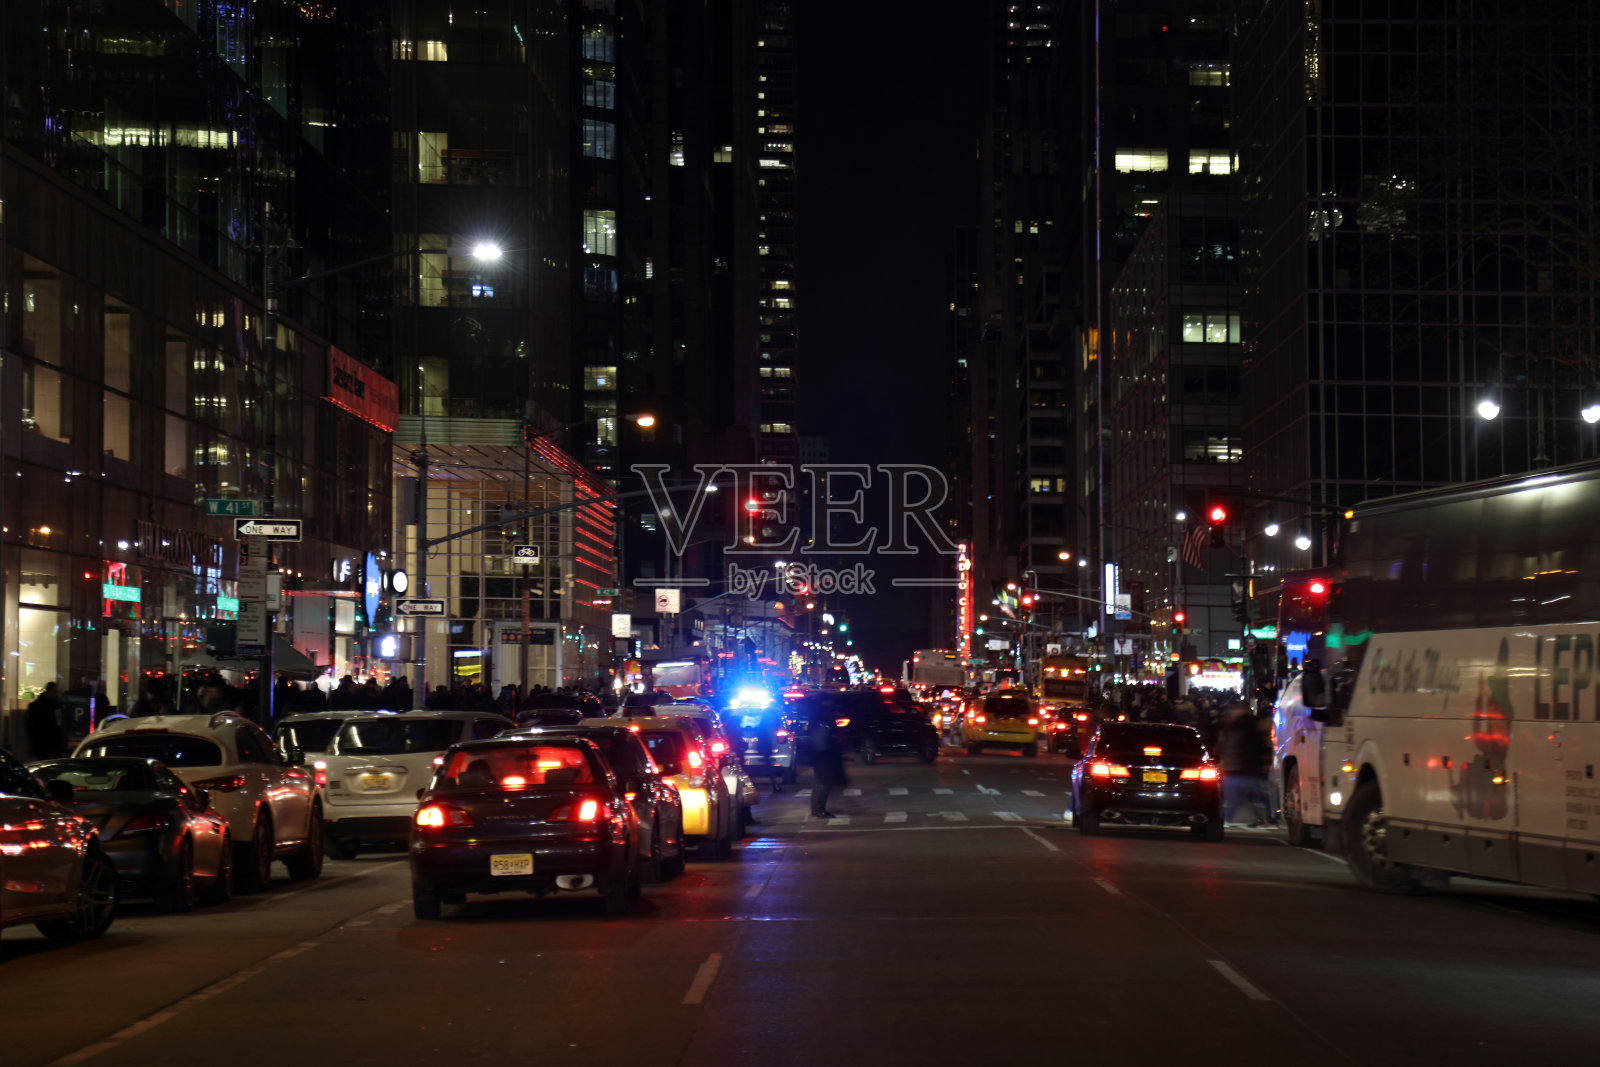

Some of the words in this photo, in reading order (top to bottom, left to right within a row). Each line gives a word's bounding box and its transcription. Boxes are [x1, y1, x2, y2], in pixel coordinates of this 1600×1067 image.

[208, 501, 219, 513] W
[225, 502, 239, 514] 41
[245, 526, 263, 534] ONE
[272, 526, 293, 534] WAY
[1534, 634, 1600, 720] LEP
